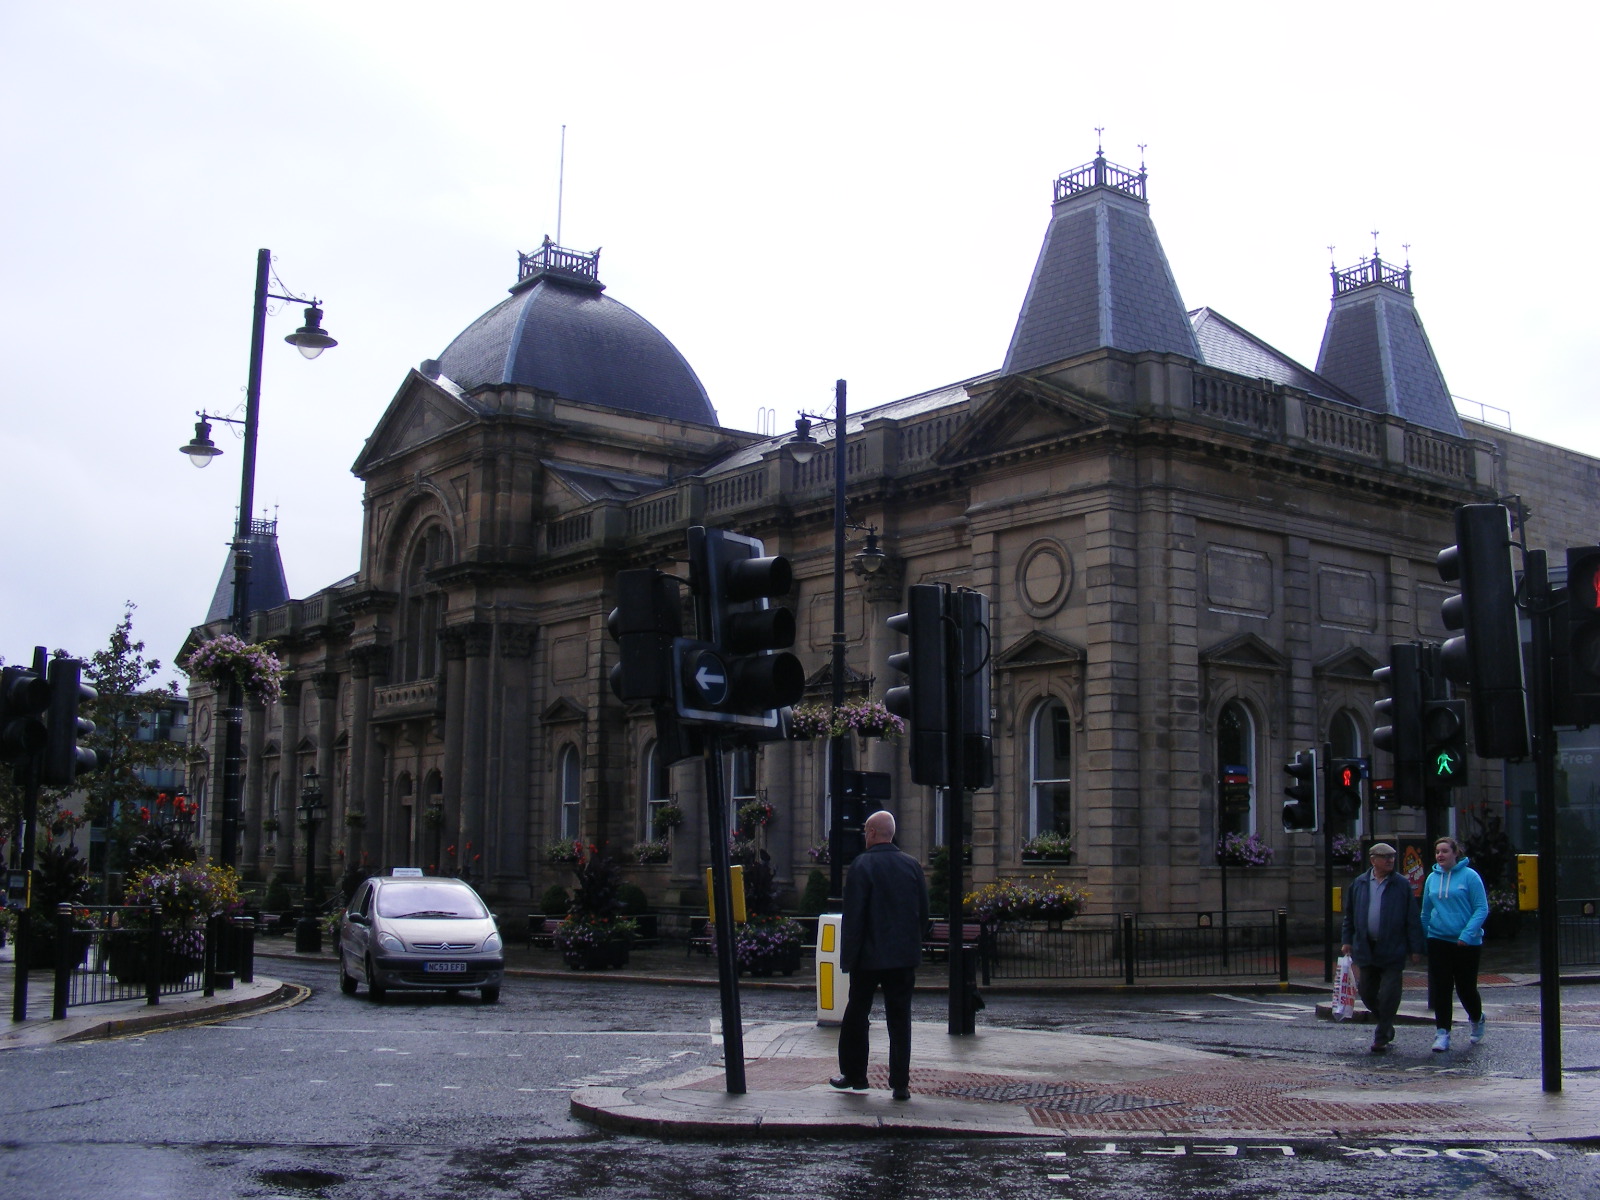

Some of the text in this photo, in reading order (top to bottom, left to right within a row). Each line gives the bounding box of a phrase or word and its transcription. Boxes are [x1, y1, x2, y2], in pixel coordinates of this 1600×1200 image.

[1560, 753, 1592, 764] Free
[429, 963, 465, 971] NC53 EFB
[1083, 1143, 1557, 1162] LOOK LEFT
